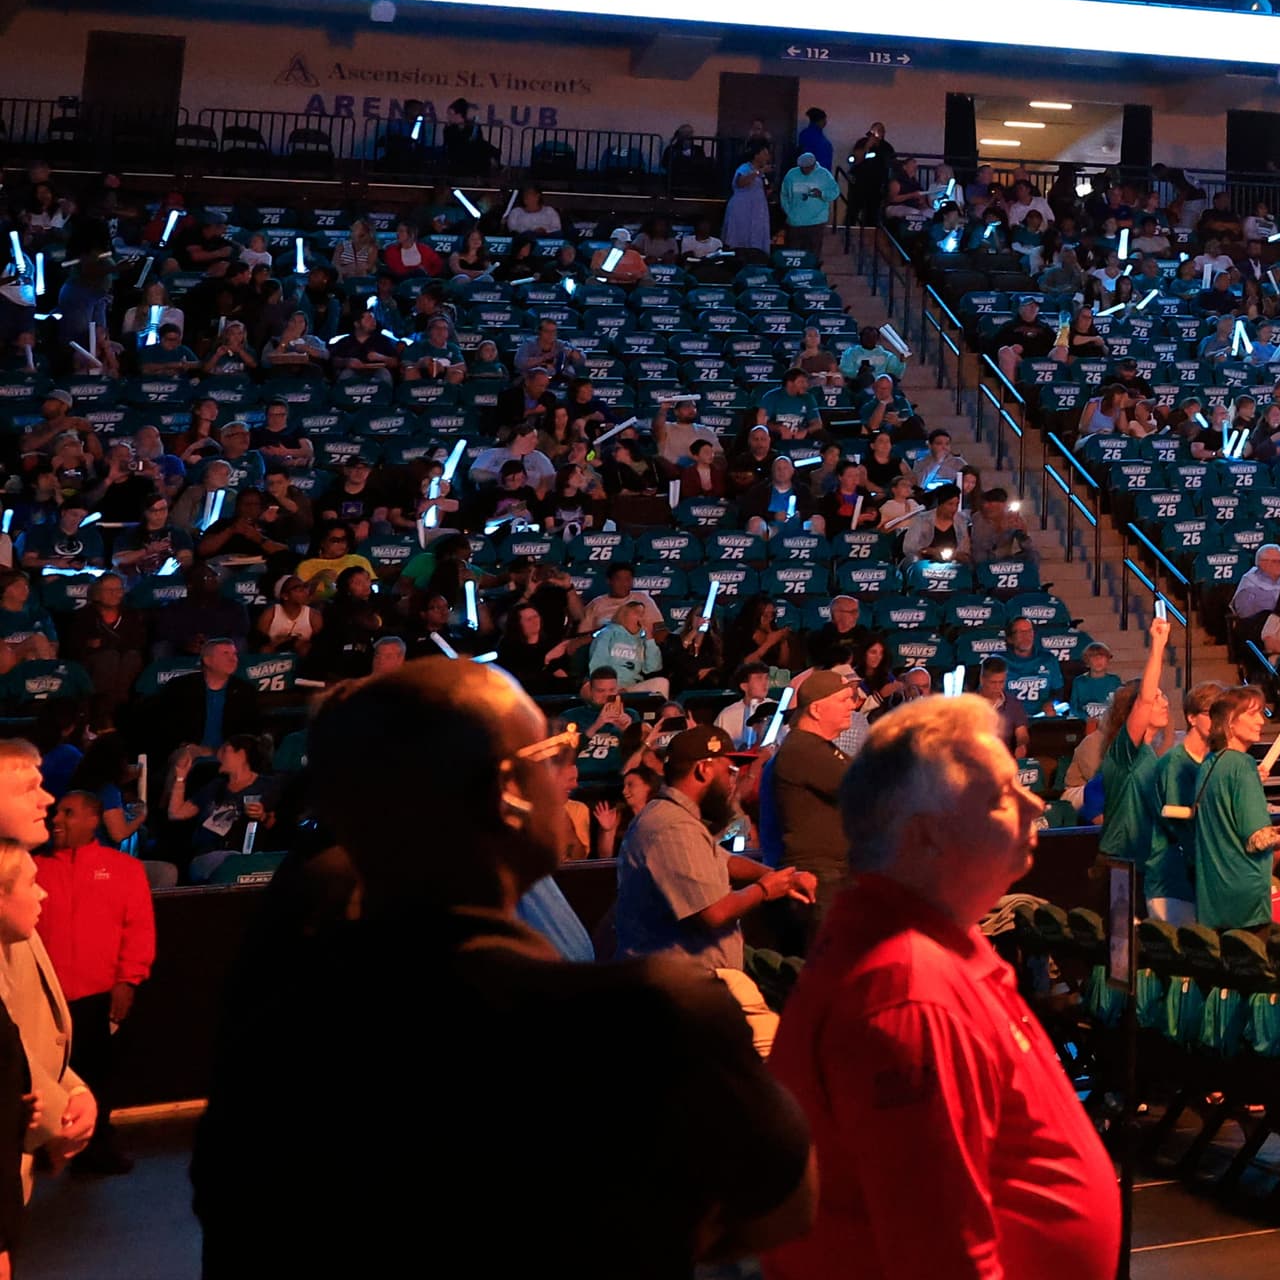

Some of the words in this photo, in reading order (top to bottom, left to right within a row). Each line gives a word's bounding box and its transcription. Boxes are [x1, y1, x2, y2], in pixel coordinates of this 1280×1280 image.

[806, 48, 830, 59] 112
[869, 52, 891, 64] 113
[328, 62, 449, 87] Ascension
[455, 70, 484, 89] St.
[488, 72, 593, 94] Vincent's
[1103, 449, 1121, 460] 26
[1159, 450, 1175, 461] 26
[1128, 476, 1145, 487] 26
[1185, 476, 1201, 487] 26
[1236, 475, 1252, 486] 26
[1158, 504, 1176, 516] 26
[1217, 508, 1233, 519] 26
[1183, 532, 1200, 545] 26
[589, 547, 612, 560] 26
[849, 545, 870, 557] 26
[1215, 566, 1232, 578] 26
